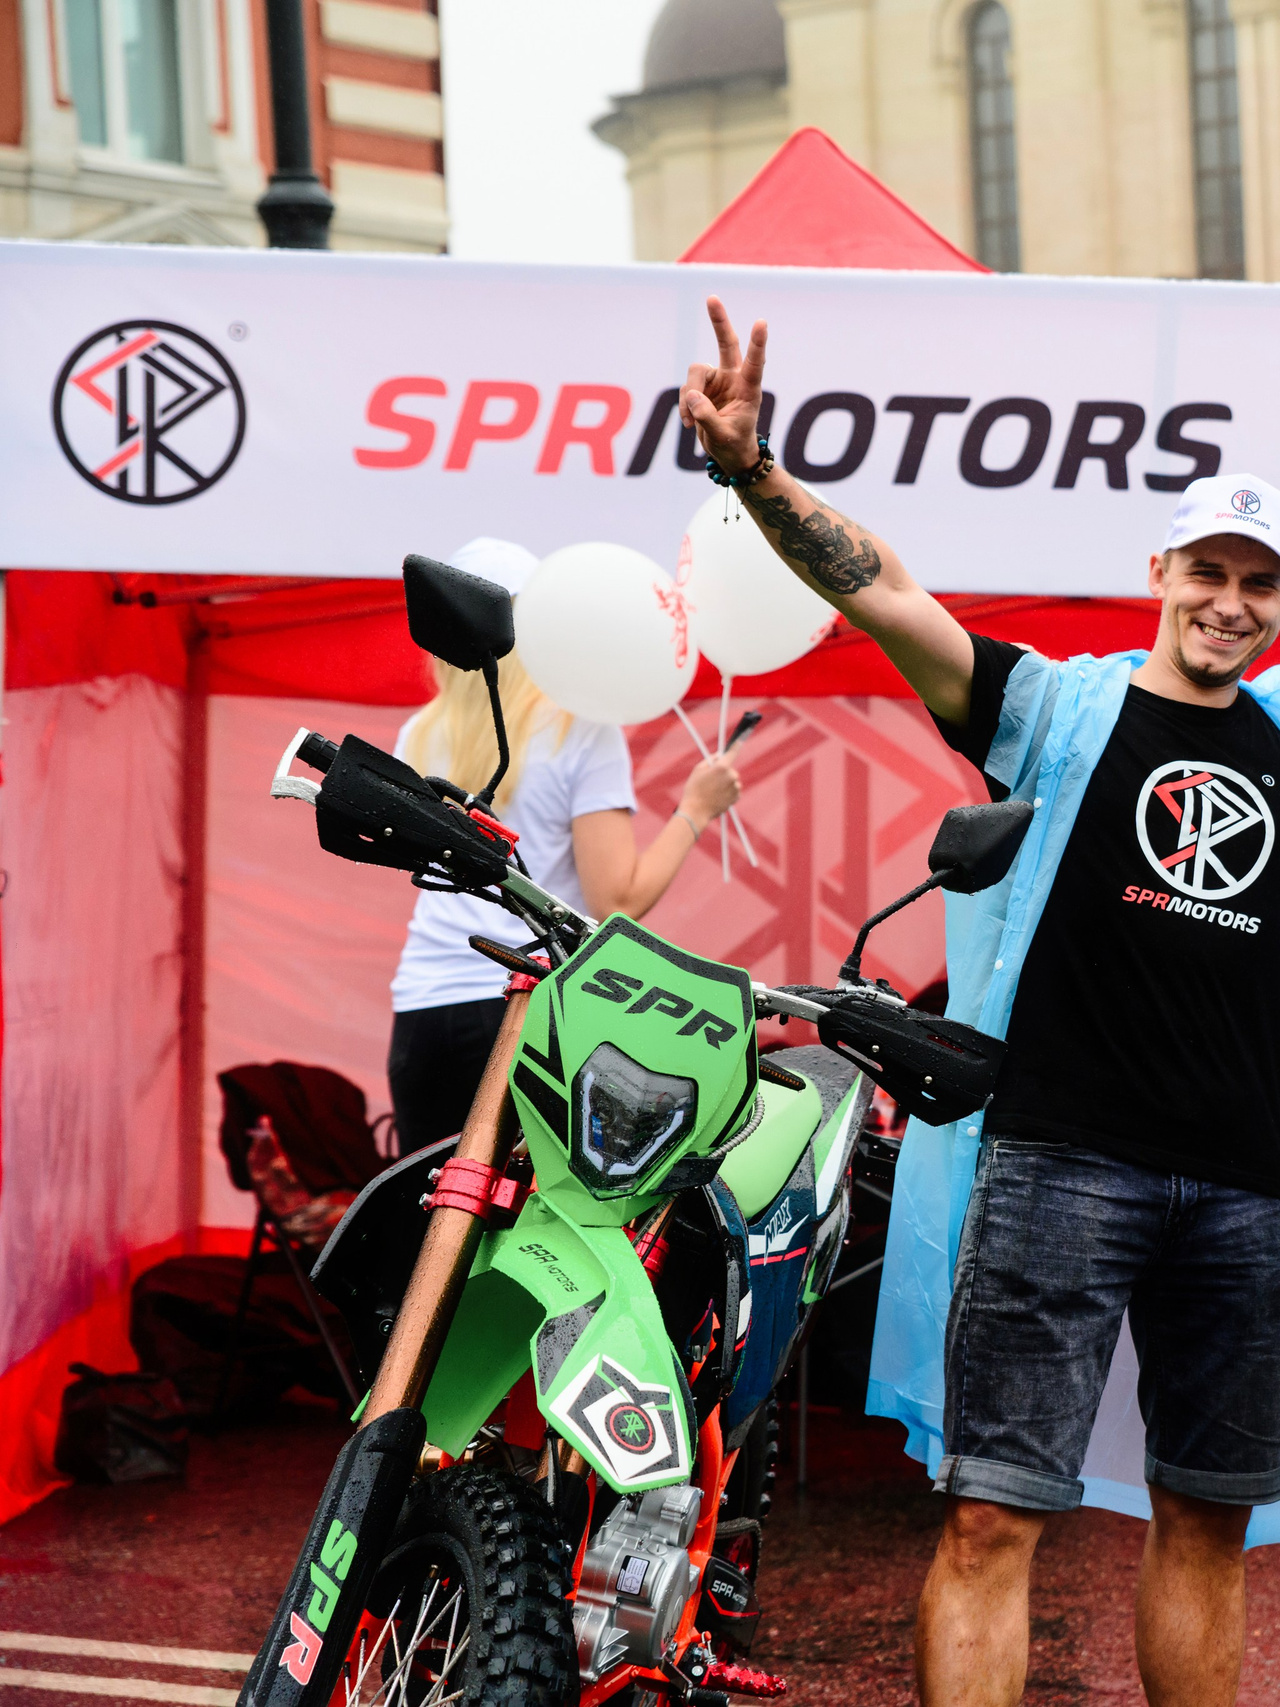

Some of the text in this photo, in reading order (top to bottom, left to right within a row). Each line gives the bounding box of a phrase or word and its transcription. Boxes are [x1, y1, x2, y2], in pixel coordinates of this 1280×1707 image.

[1214, 511, 1272, 531] SPRMOTORS
[1121, 884, 1263, 935] SPRMOTORS
[580, 968, 738, 1051] SPR
[763, 1194, 794, 1267] MAX
[517, 1243, 579, 1293] SPR MOTORS
[278, 1518, 359, 1687] SPR
[711, 1579, 735, 1598] SPR
